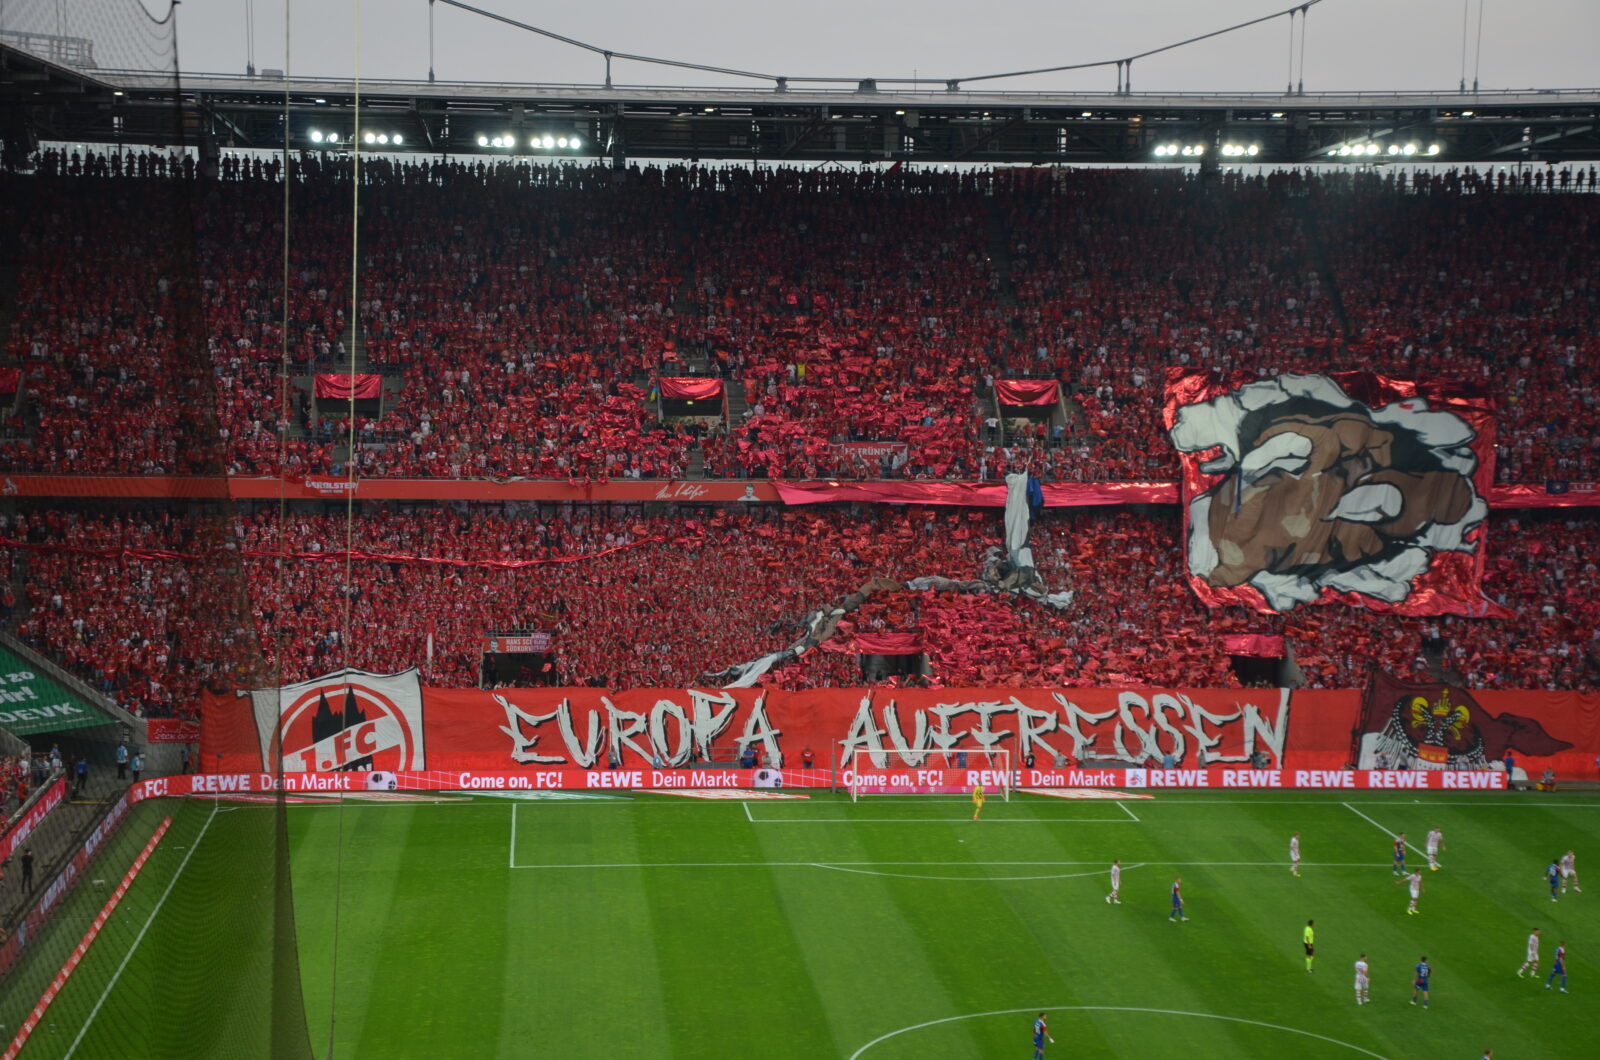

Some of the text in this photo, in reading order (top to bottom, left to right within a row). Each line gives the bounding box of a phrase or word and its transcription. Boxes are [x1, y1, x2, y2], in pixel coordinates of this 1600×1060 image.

[492, 688, 1292, 769] EUROPA AUFFRESSEN
[145, 778, 168, 798] FC!
[192, 774, 250, 792] REWE
[260, 774, 296, 791] Dein
[301, 774, 350, 790] Markt
[459, 771, 738, 790] Come on, FC! REWE Dein Markt
[842, 769, 1503, 788] Come on, FC! REWE Dein Markt REWE REWE REWE REWE REWE
